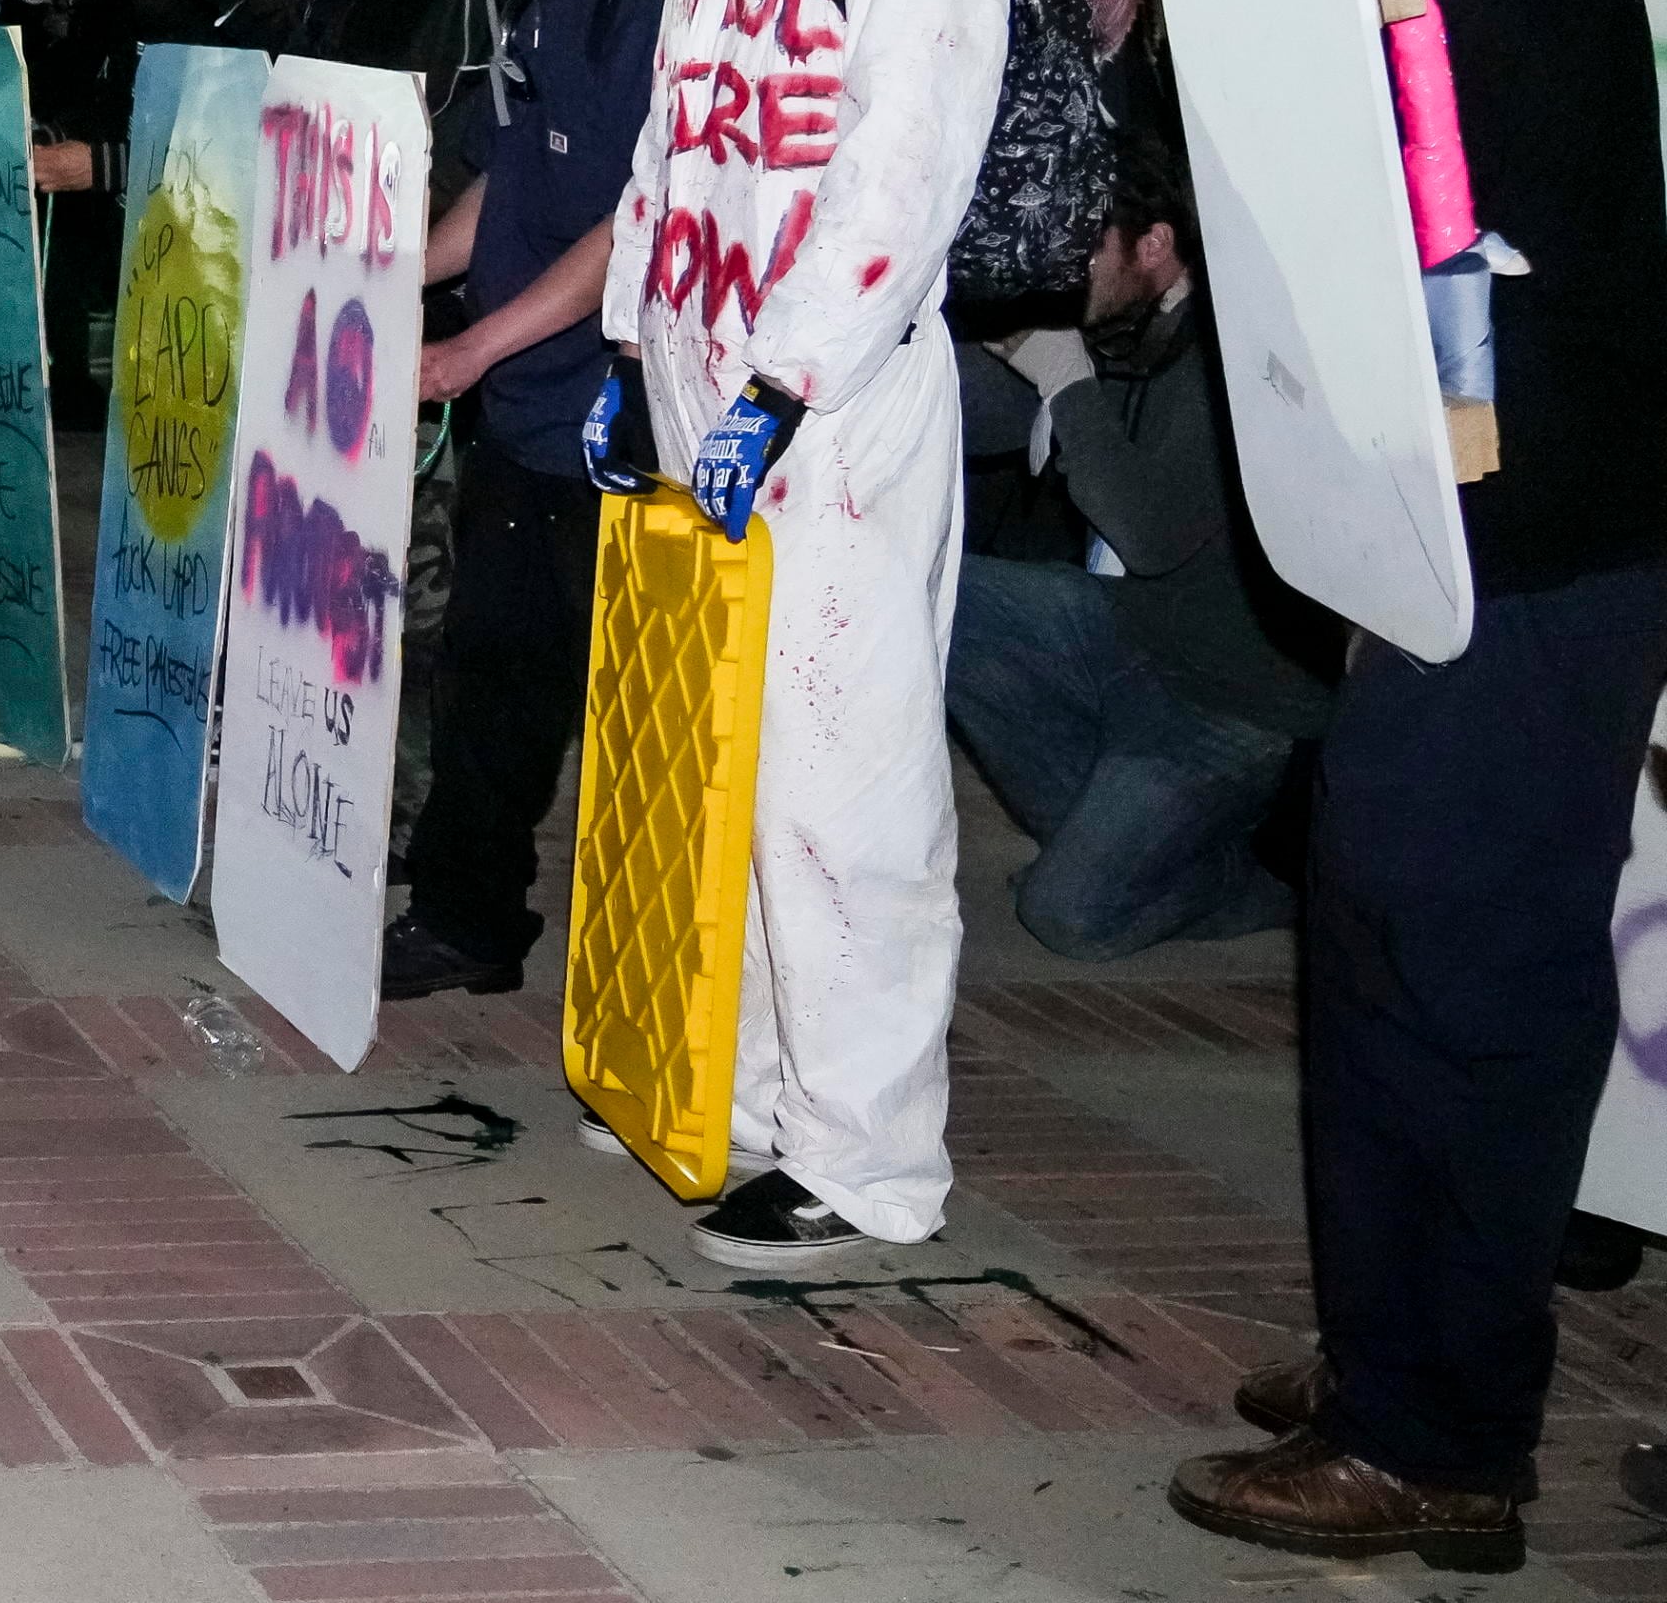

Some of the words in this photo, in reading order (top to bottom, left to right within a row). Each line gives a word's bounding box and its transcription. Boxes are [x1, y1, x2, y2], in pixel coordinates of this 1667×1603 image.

[665, 61, 844, 170] IRE
[260, 102, 355, 260] THIS
[359, 122, 402, 274] IS
[324, 686, 355, 747] US
[262, 725, 354, 880] ALONE
